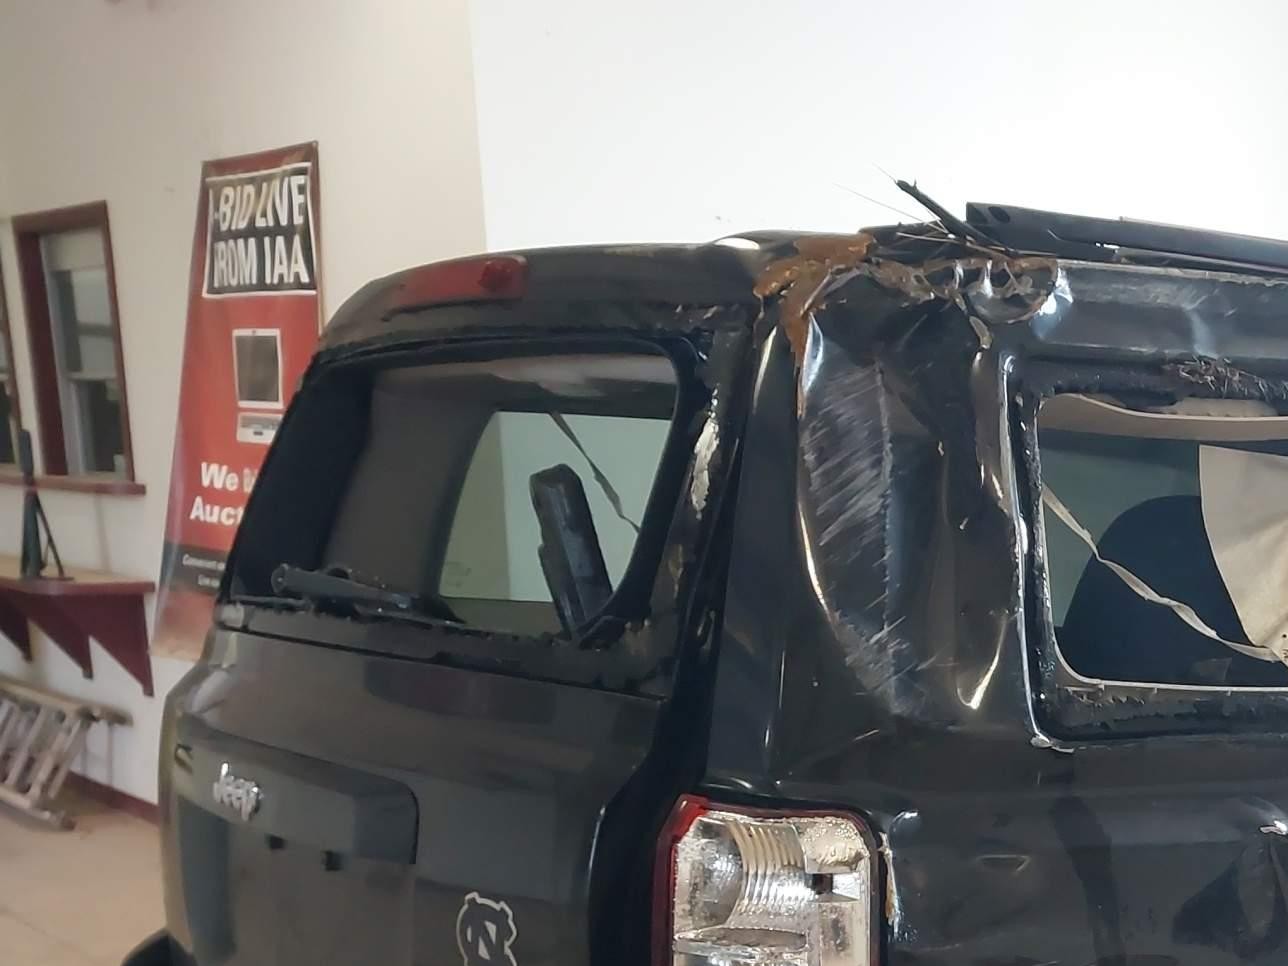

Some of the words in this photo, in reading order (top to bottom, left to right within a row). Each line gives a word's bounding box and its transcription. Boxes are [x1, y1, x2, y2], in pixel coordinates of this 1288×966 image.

[255, 175, 305, 227] LIVE
[264, 234, 310, 285] IAA
[201, 462, 239, 491] We
